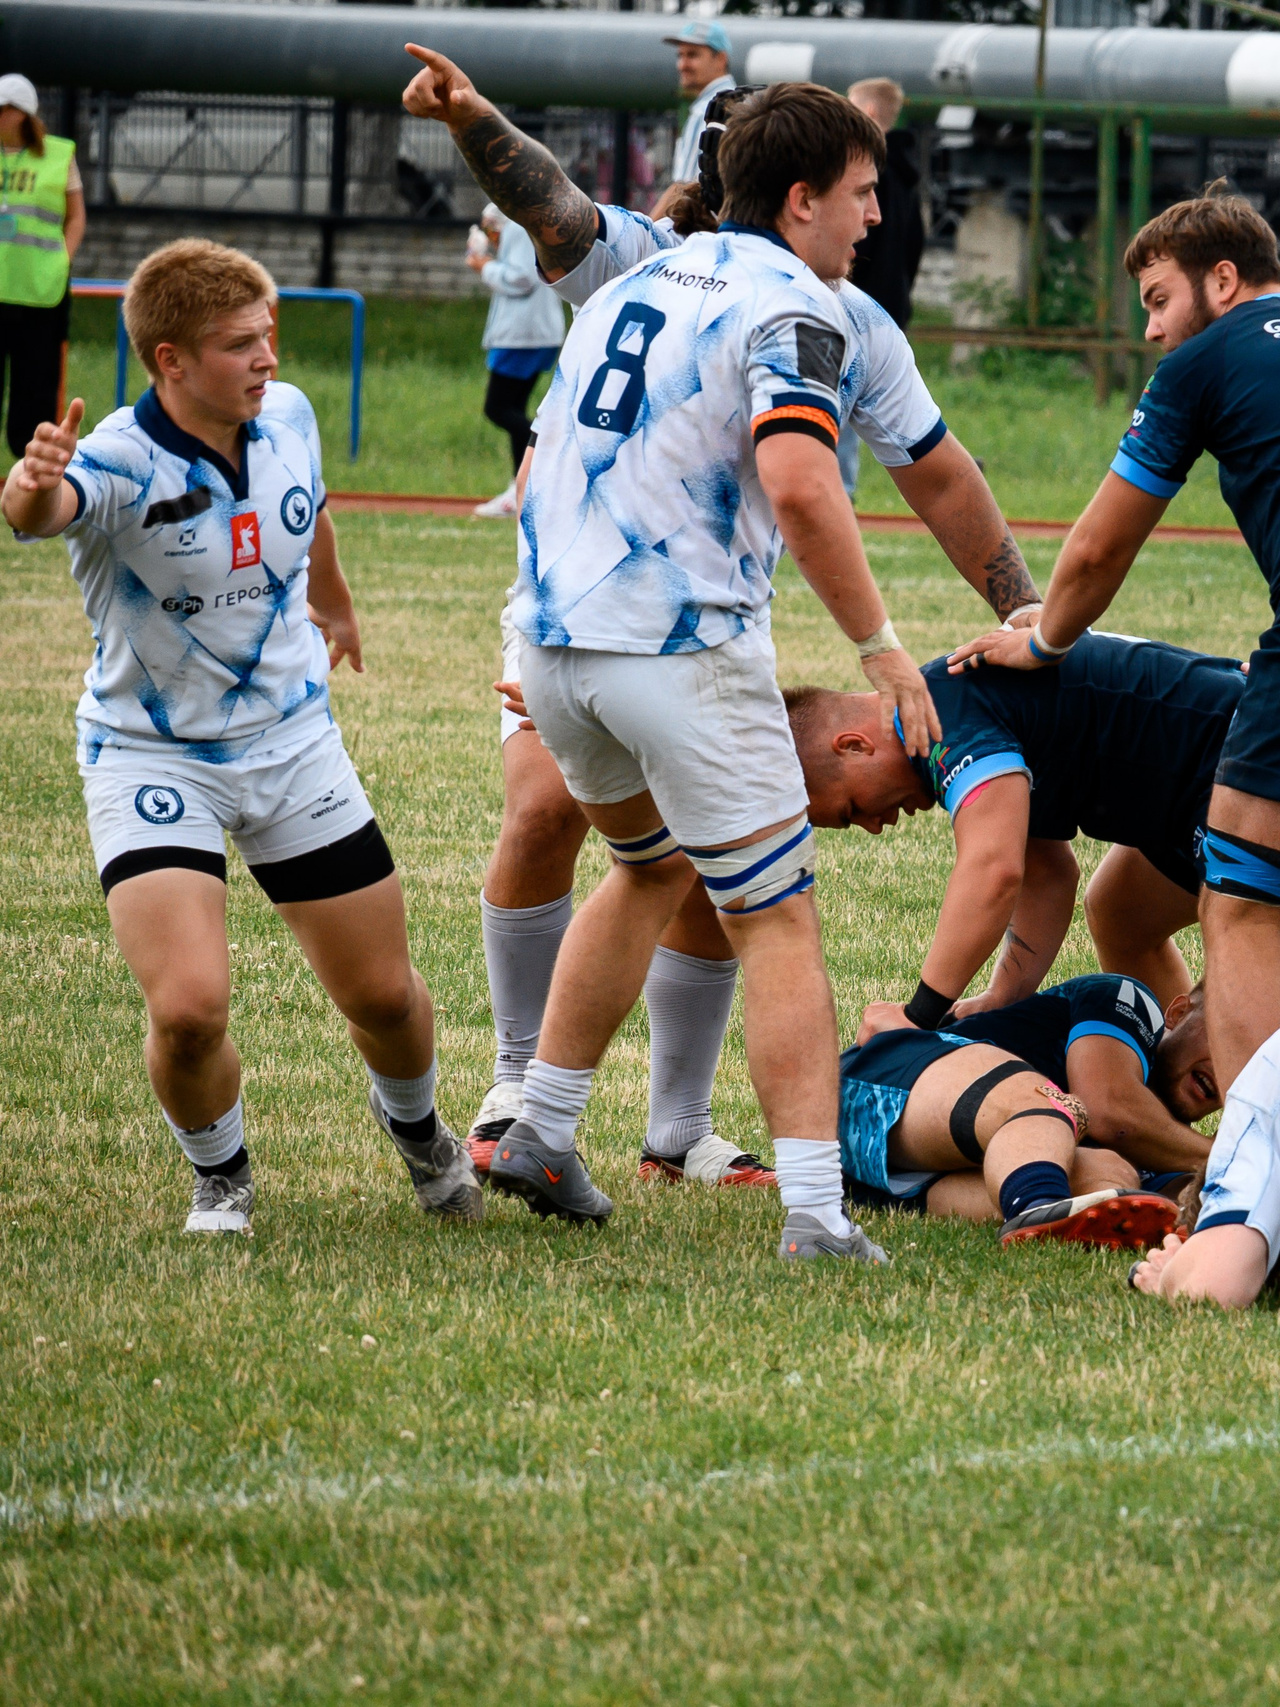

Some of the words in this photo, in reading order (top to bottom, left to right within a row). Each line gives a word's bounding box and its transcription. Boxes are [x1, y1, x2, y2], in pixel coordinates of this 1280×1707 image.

[578, 301, 666, 436] 8
[164, 547, 208, 557] centurion
[311, 797, 350, 819] centurion
